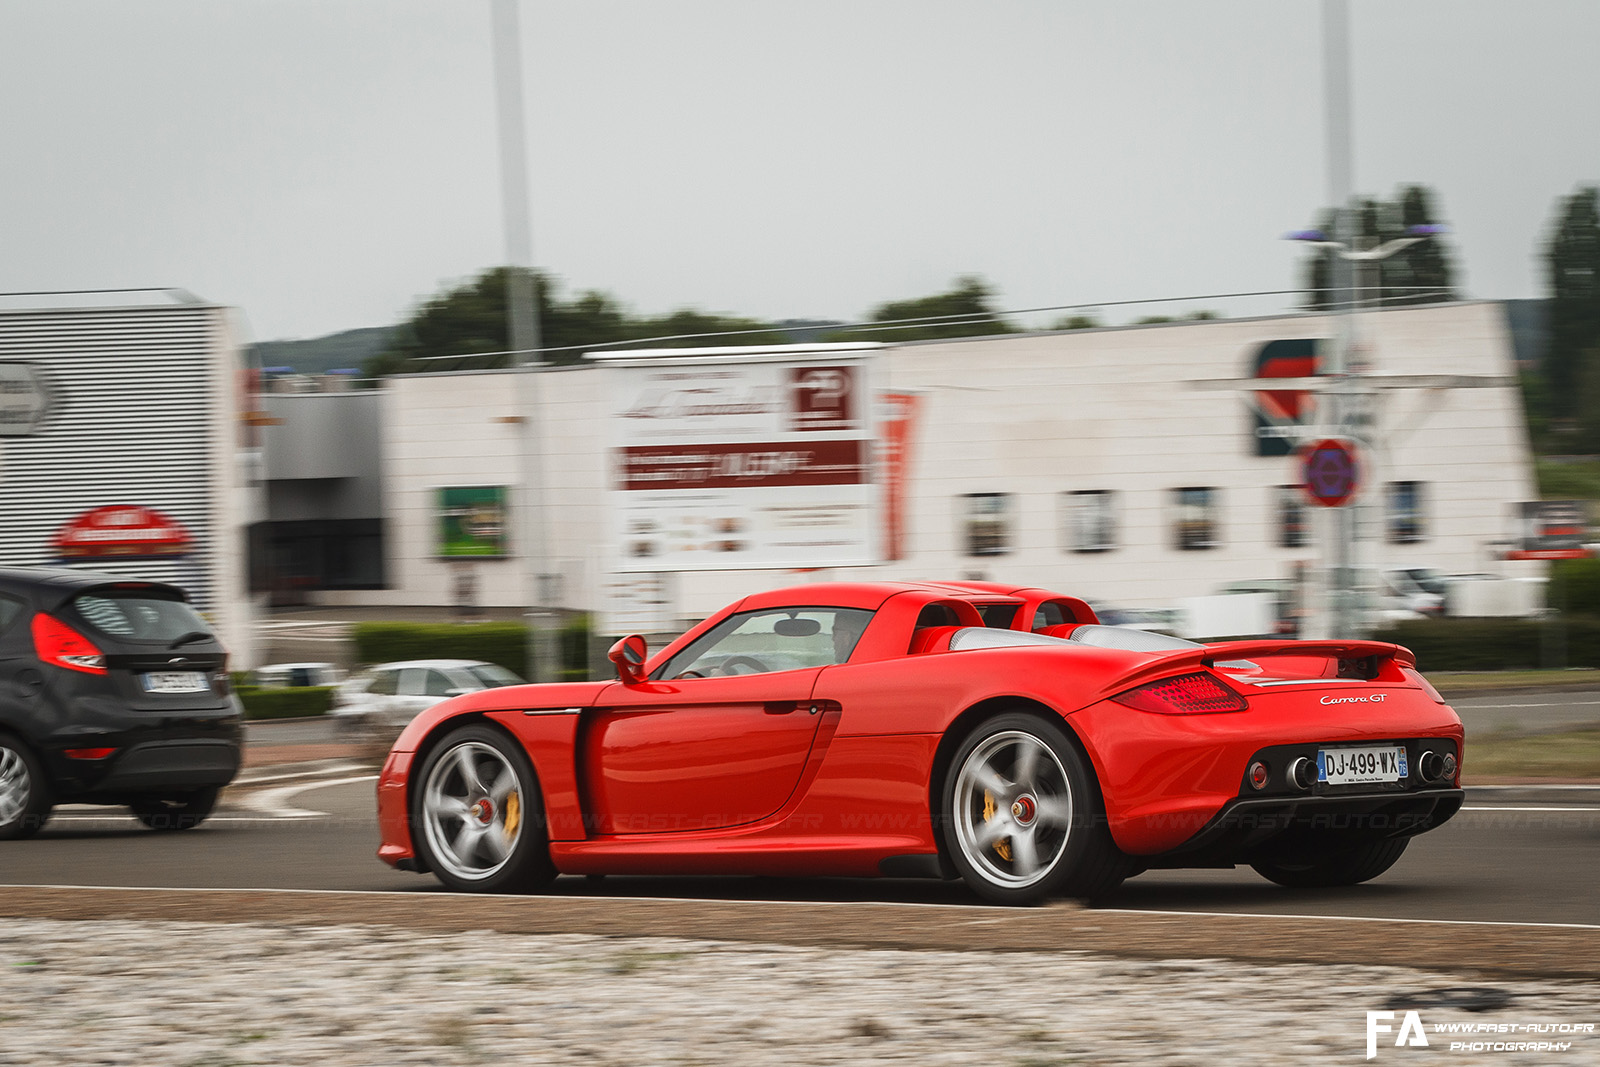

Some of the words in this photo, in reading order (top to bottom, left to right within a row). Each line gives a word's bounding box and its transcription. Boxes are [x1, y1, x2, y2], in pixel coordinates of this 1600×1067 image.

[1320, 695, 1369, 705] Carrera
[1369, 693, 1388, 703] GT
[1325, 752, 1398, 776] DJ-499-WX
